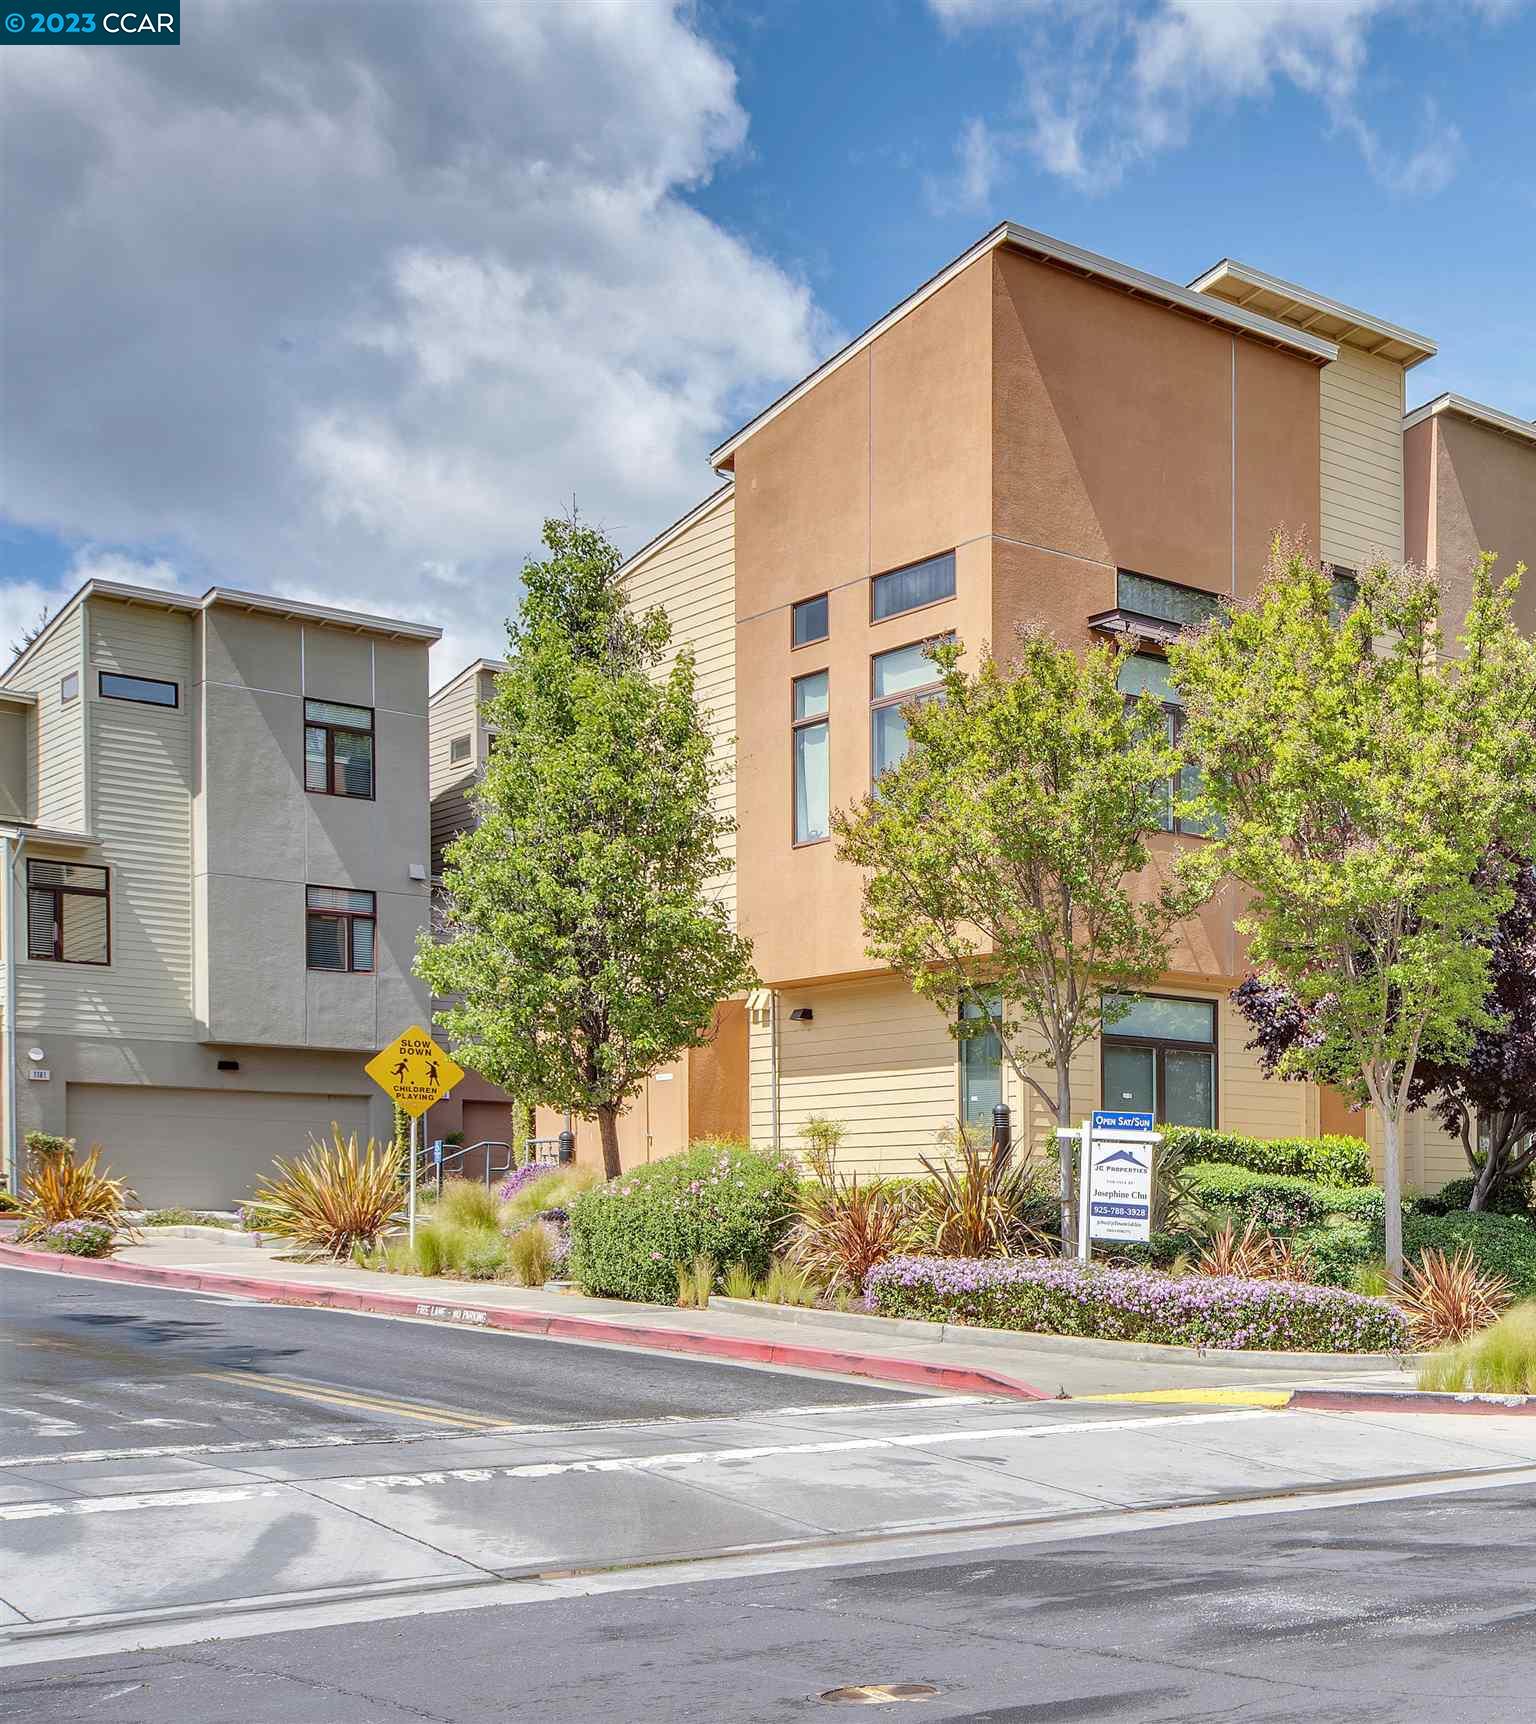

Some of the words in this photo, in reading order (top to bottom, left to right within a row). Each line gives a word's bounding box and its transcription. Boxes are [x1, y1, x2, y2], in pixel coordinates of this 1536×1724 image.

[400, 1039, 431, 1048] SLOW
[399, 1047, 432, 1056] DOWN
[393, 1085, 437, 1094] CHILDREN
[395, 1093, 434, 1101] PLAYING
[1095, 1116, 1116, 1126] OPEN
[1106, 1166, 1147, 1174] PROPERTIES
[1093, 1189, 1130, 1200] Josephine
